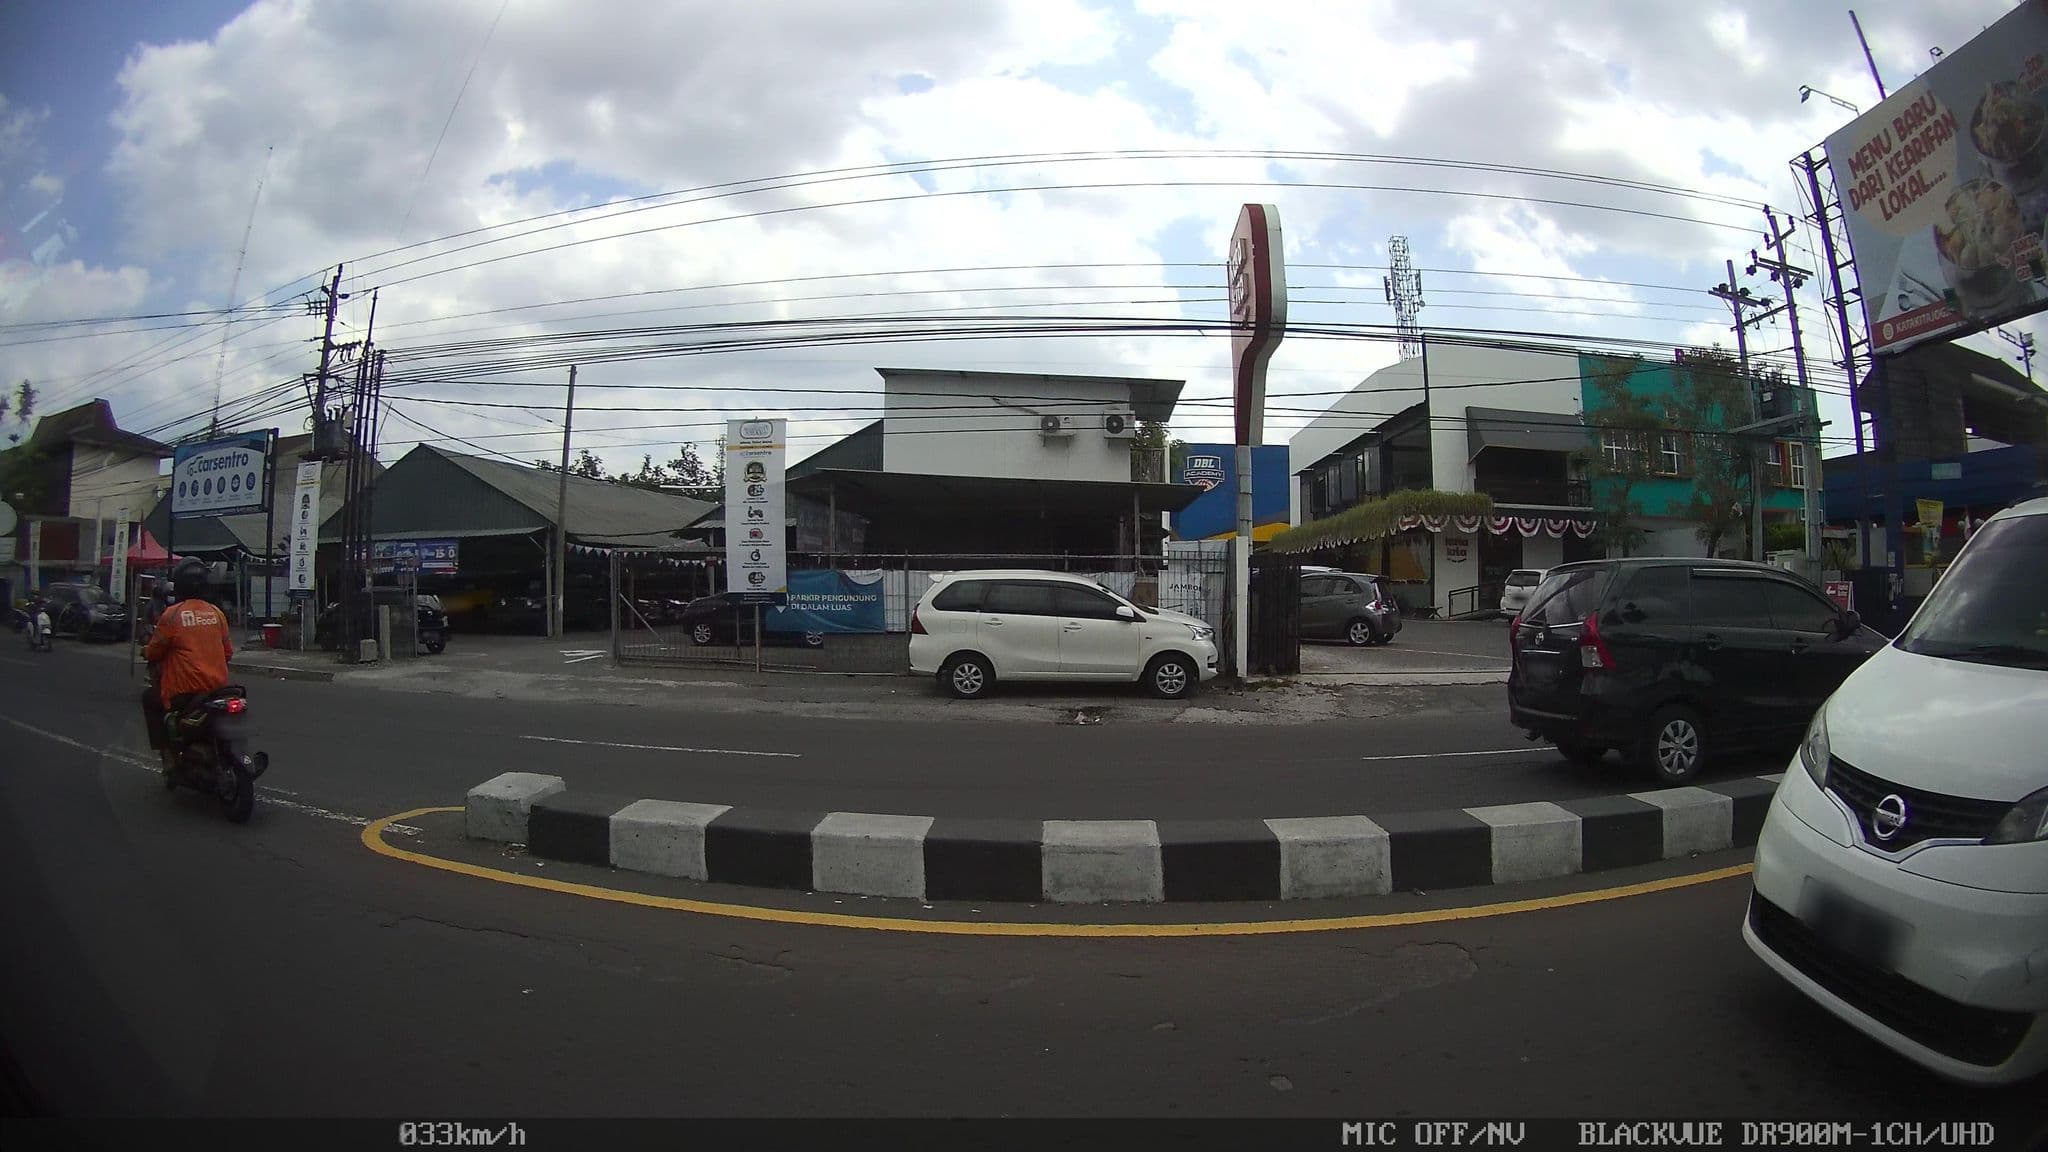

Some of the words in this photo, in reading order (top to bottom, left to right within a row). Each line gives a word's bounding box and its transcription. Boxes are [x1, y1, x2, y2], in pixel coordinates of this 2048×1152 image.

[1848, 128, 1892, 180] MENU
[1893, 90, 1937, 142] BARU
[1848, 168, 1885, 212] DARI
[1885, 108, 1958, 184] KEARIFAN
[197, 450, 249, 473] carsentro
[1193, 458, 1215, 469] DBL
[791, 594, 820, 602] PARKIR
[821, 594, 877, 602] PENGUNJUNG
[800, 603, 830, 611] DALAM
[831, 603, 852, 611] LUAS
[196, 616, 217, 626] Food
